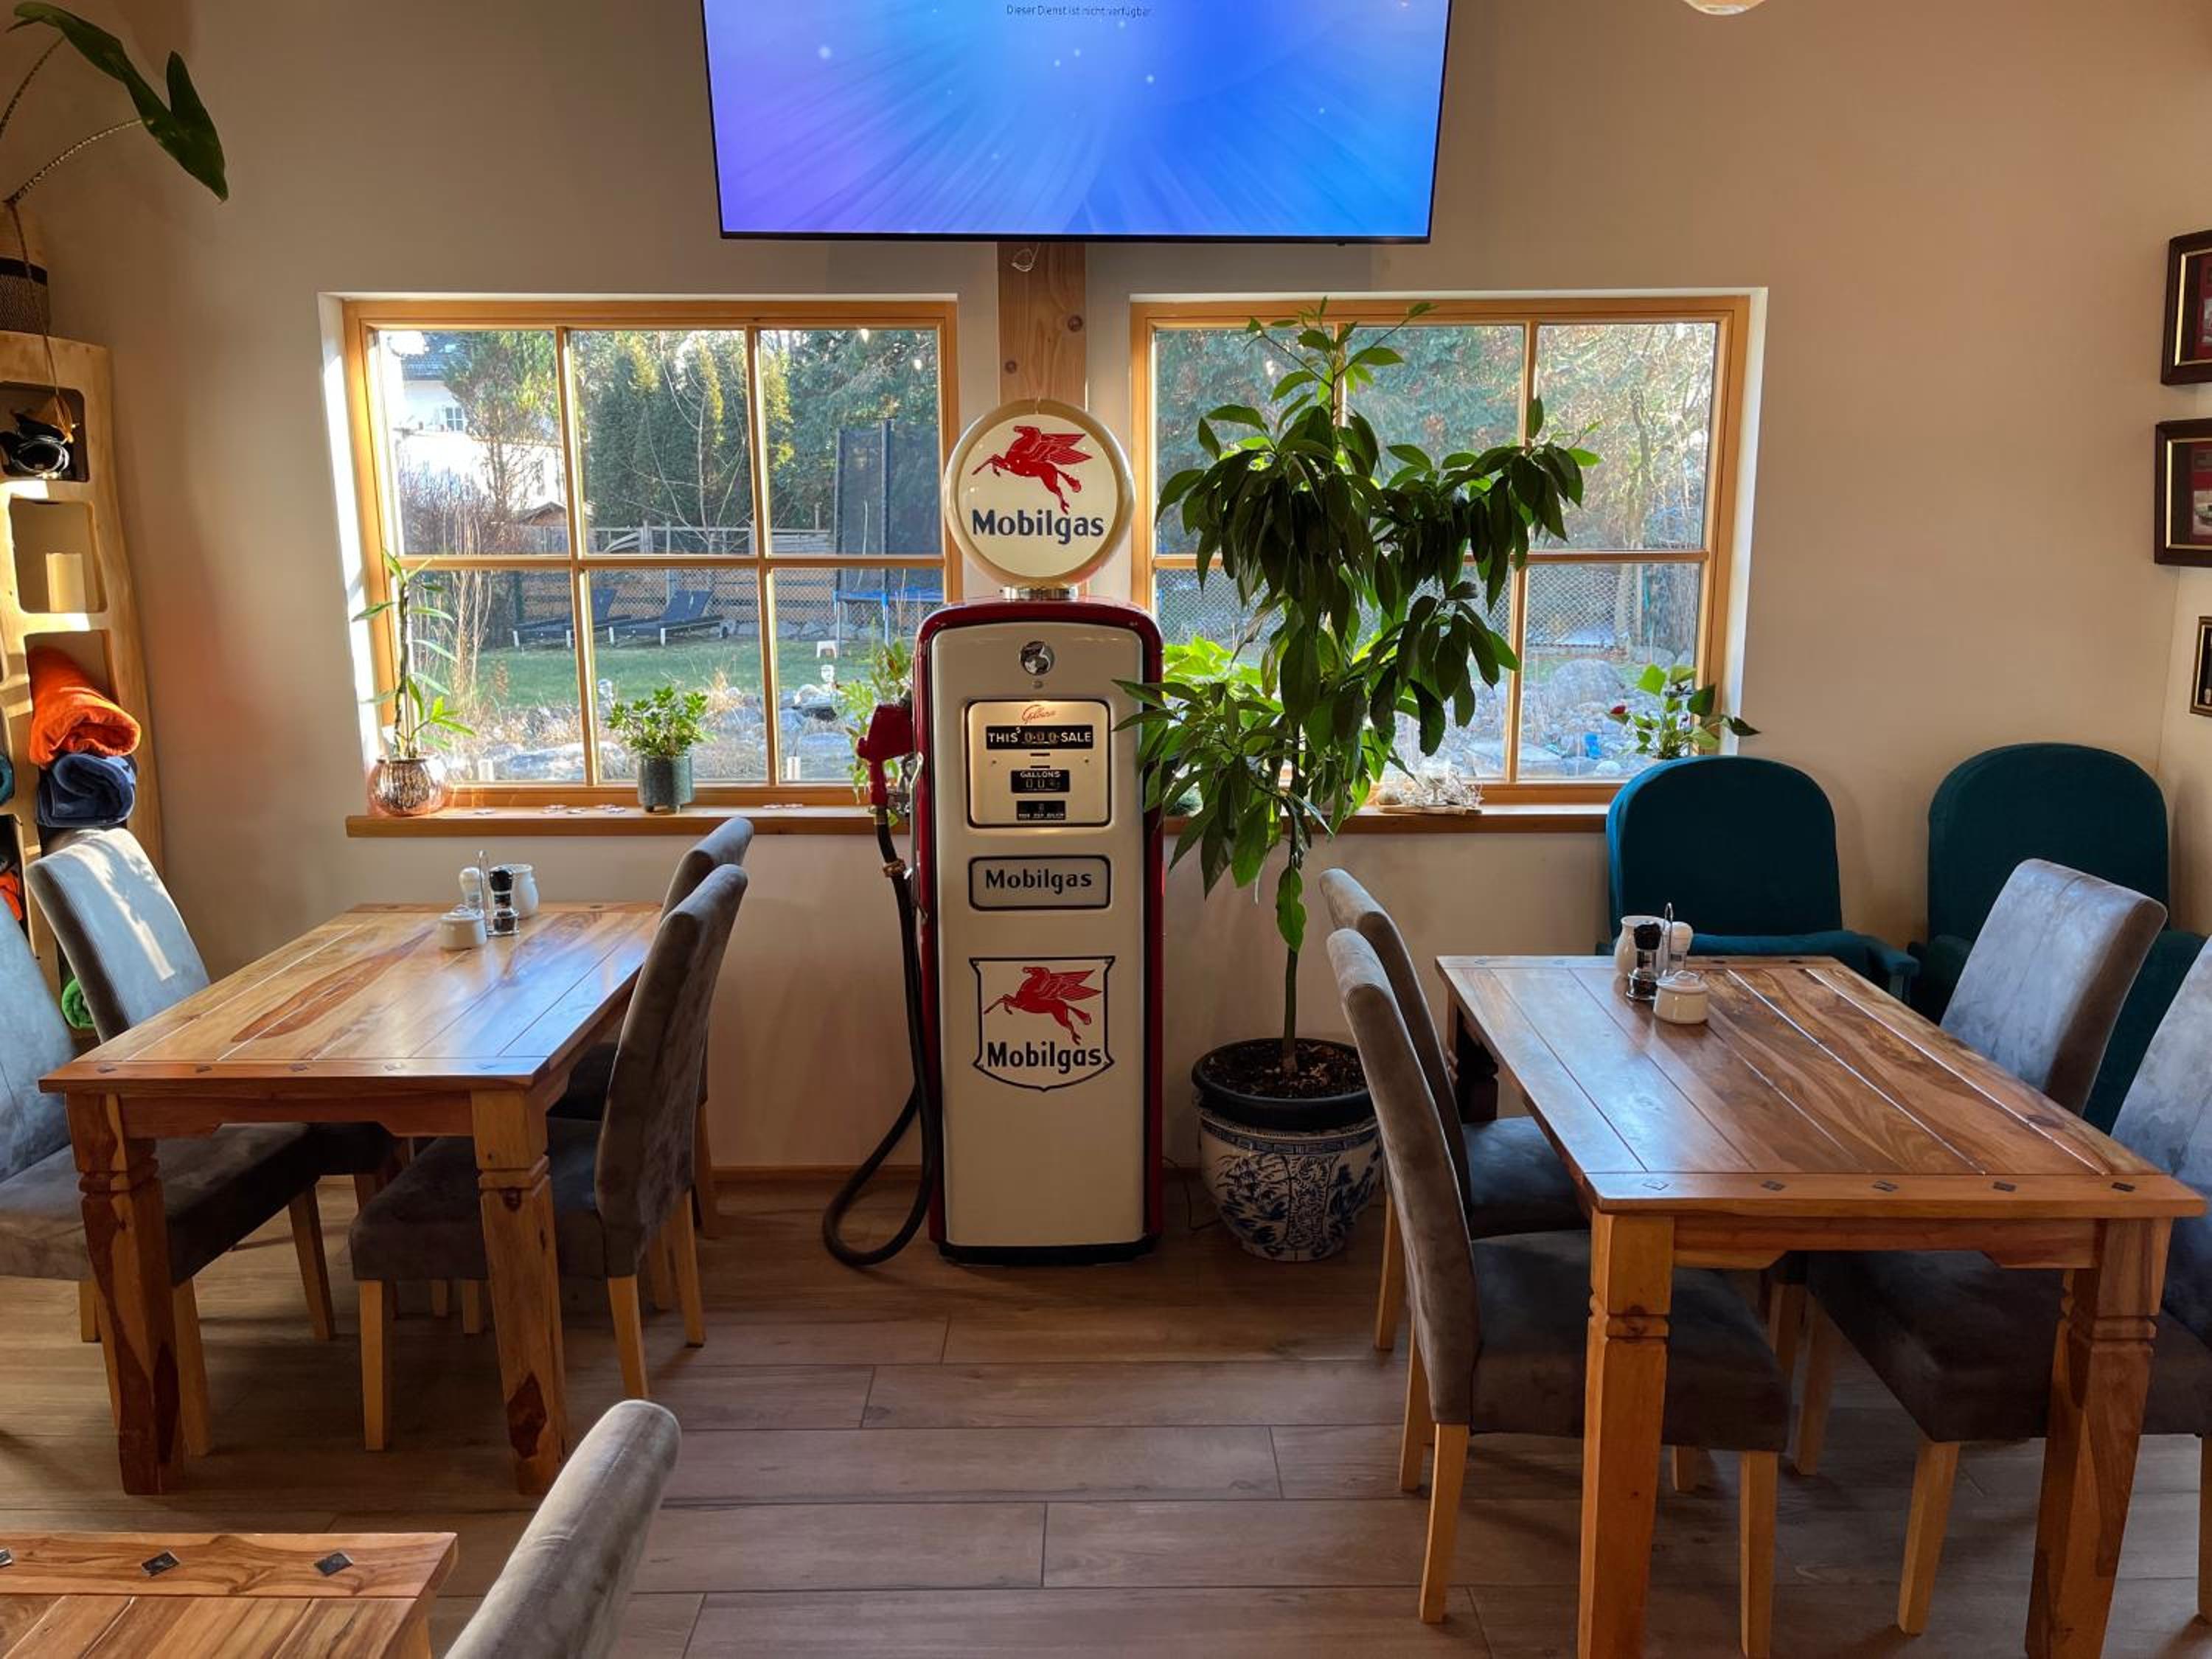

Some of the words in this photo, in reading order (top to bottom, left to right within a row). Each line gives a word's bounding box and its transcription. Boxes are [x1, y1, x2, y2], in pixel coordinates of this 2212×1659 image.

[1006, 4, 1036, 15] Dieser
[1038, 6, 1066, 15] Dienst
[972, 509, 1104, 545] Mobilgas
[988, 732, 1018, 743] THIS
[1061, 731, 1092, 743] SALE
[985, 869, 1092, 894] Mobilgas
[987, 1040, 1102, 1074] Mobilgas
